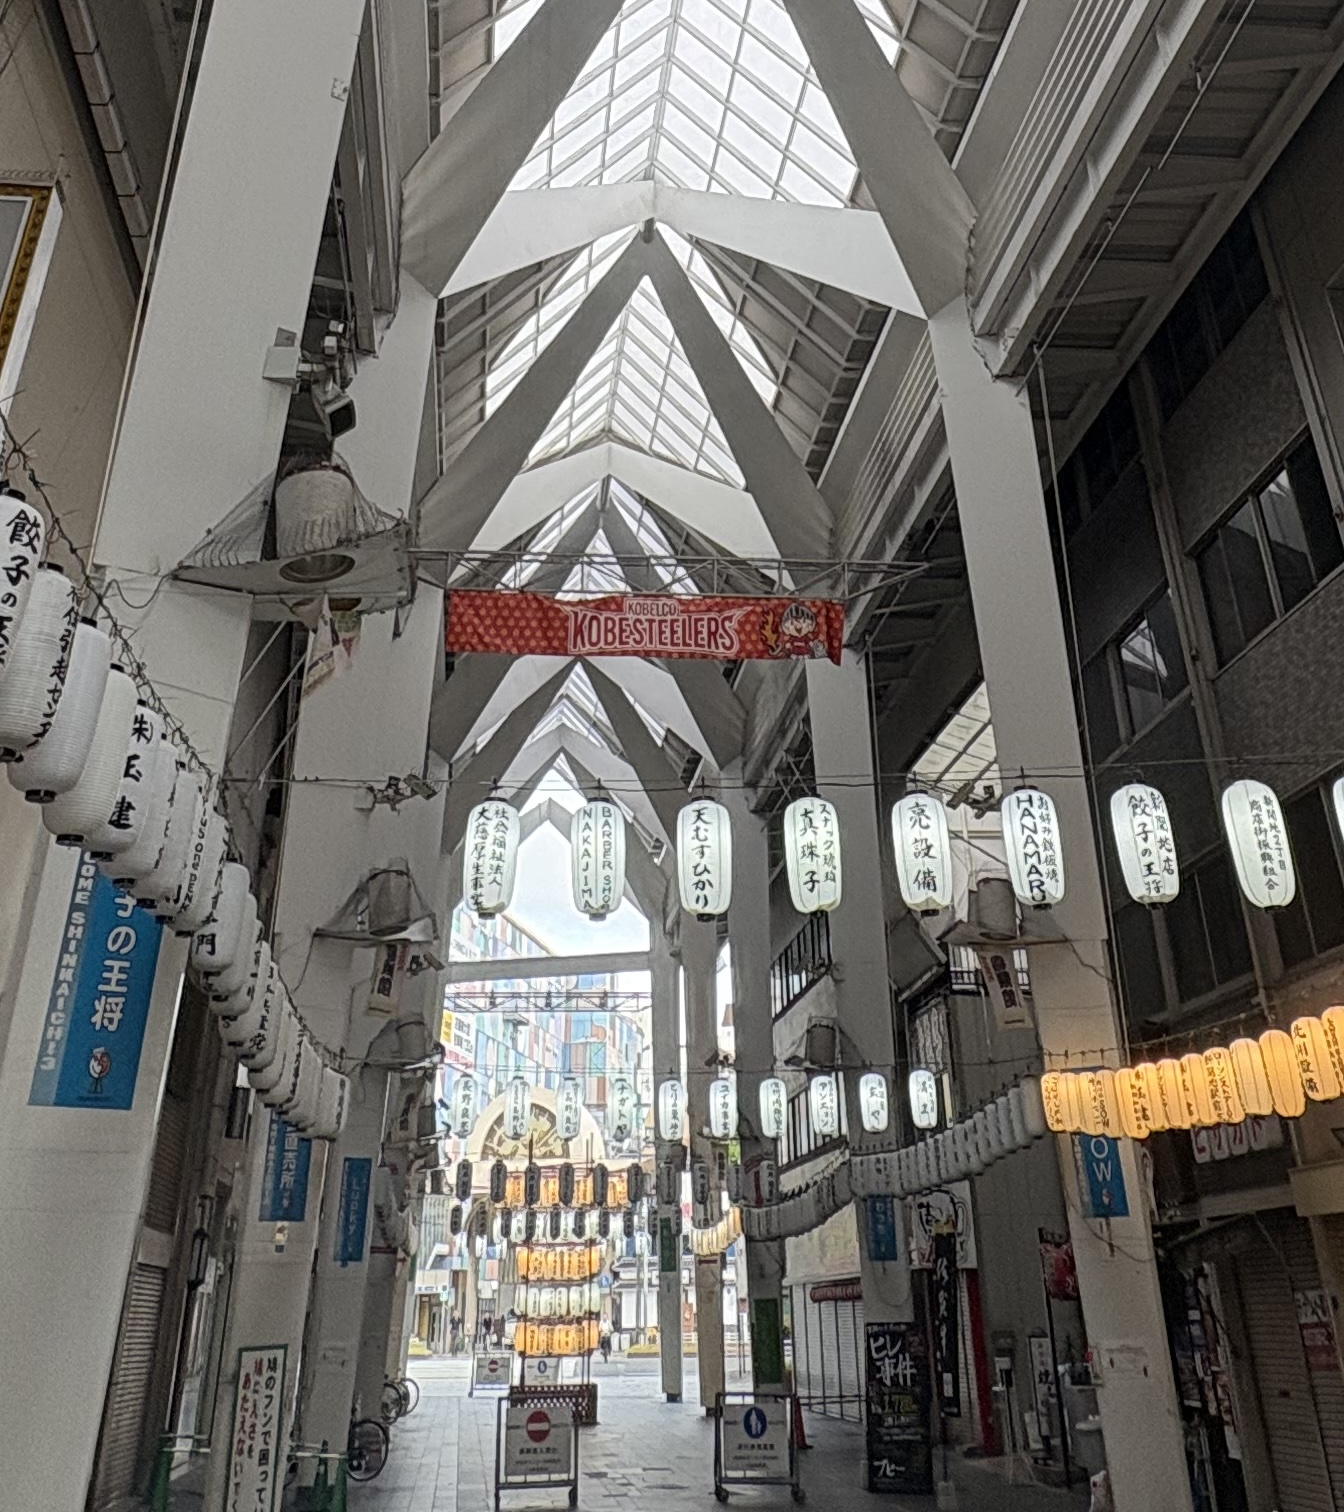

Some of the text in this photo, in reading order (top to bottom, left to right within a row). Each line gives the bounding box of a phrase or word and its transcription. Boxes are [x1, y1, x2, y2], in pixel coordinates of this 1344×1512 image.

[570, 610, 737, 653] KOBESTEELERS
[626, 601, 678, 617] KOBELCO
[580, 806, 596, 911] NAKAJIMA
[600, 805, 615, 872] BARBER
[690, 806, 714, 910] 天むすひかり
[1015, 793, 1047, 903] HANAMARU
[1127, 793, 1165, 895] 餃子の王将
[256, 1355, 278, 1512] 鳩のフンで困って
